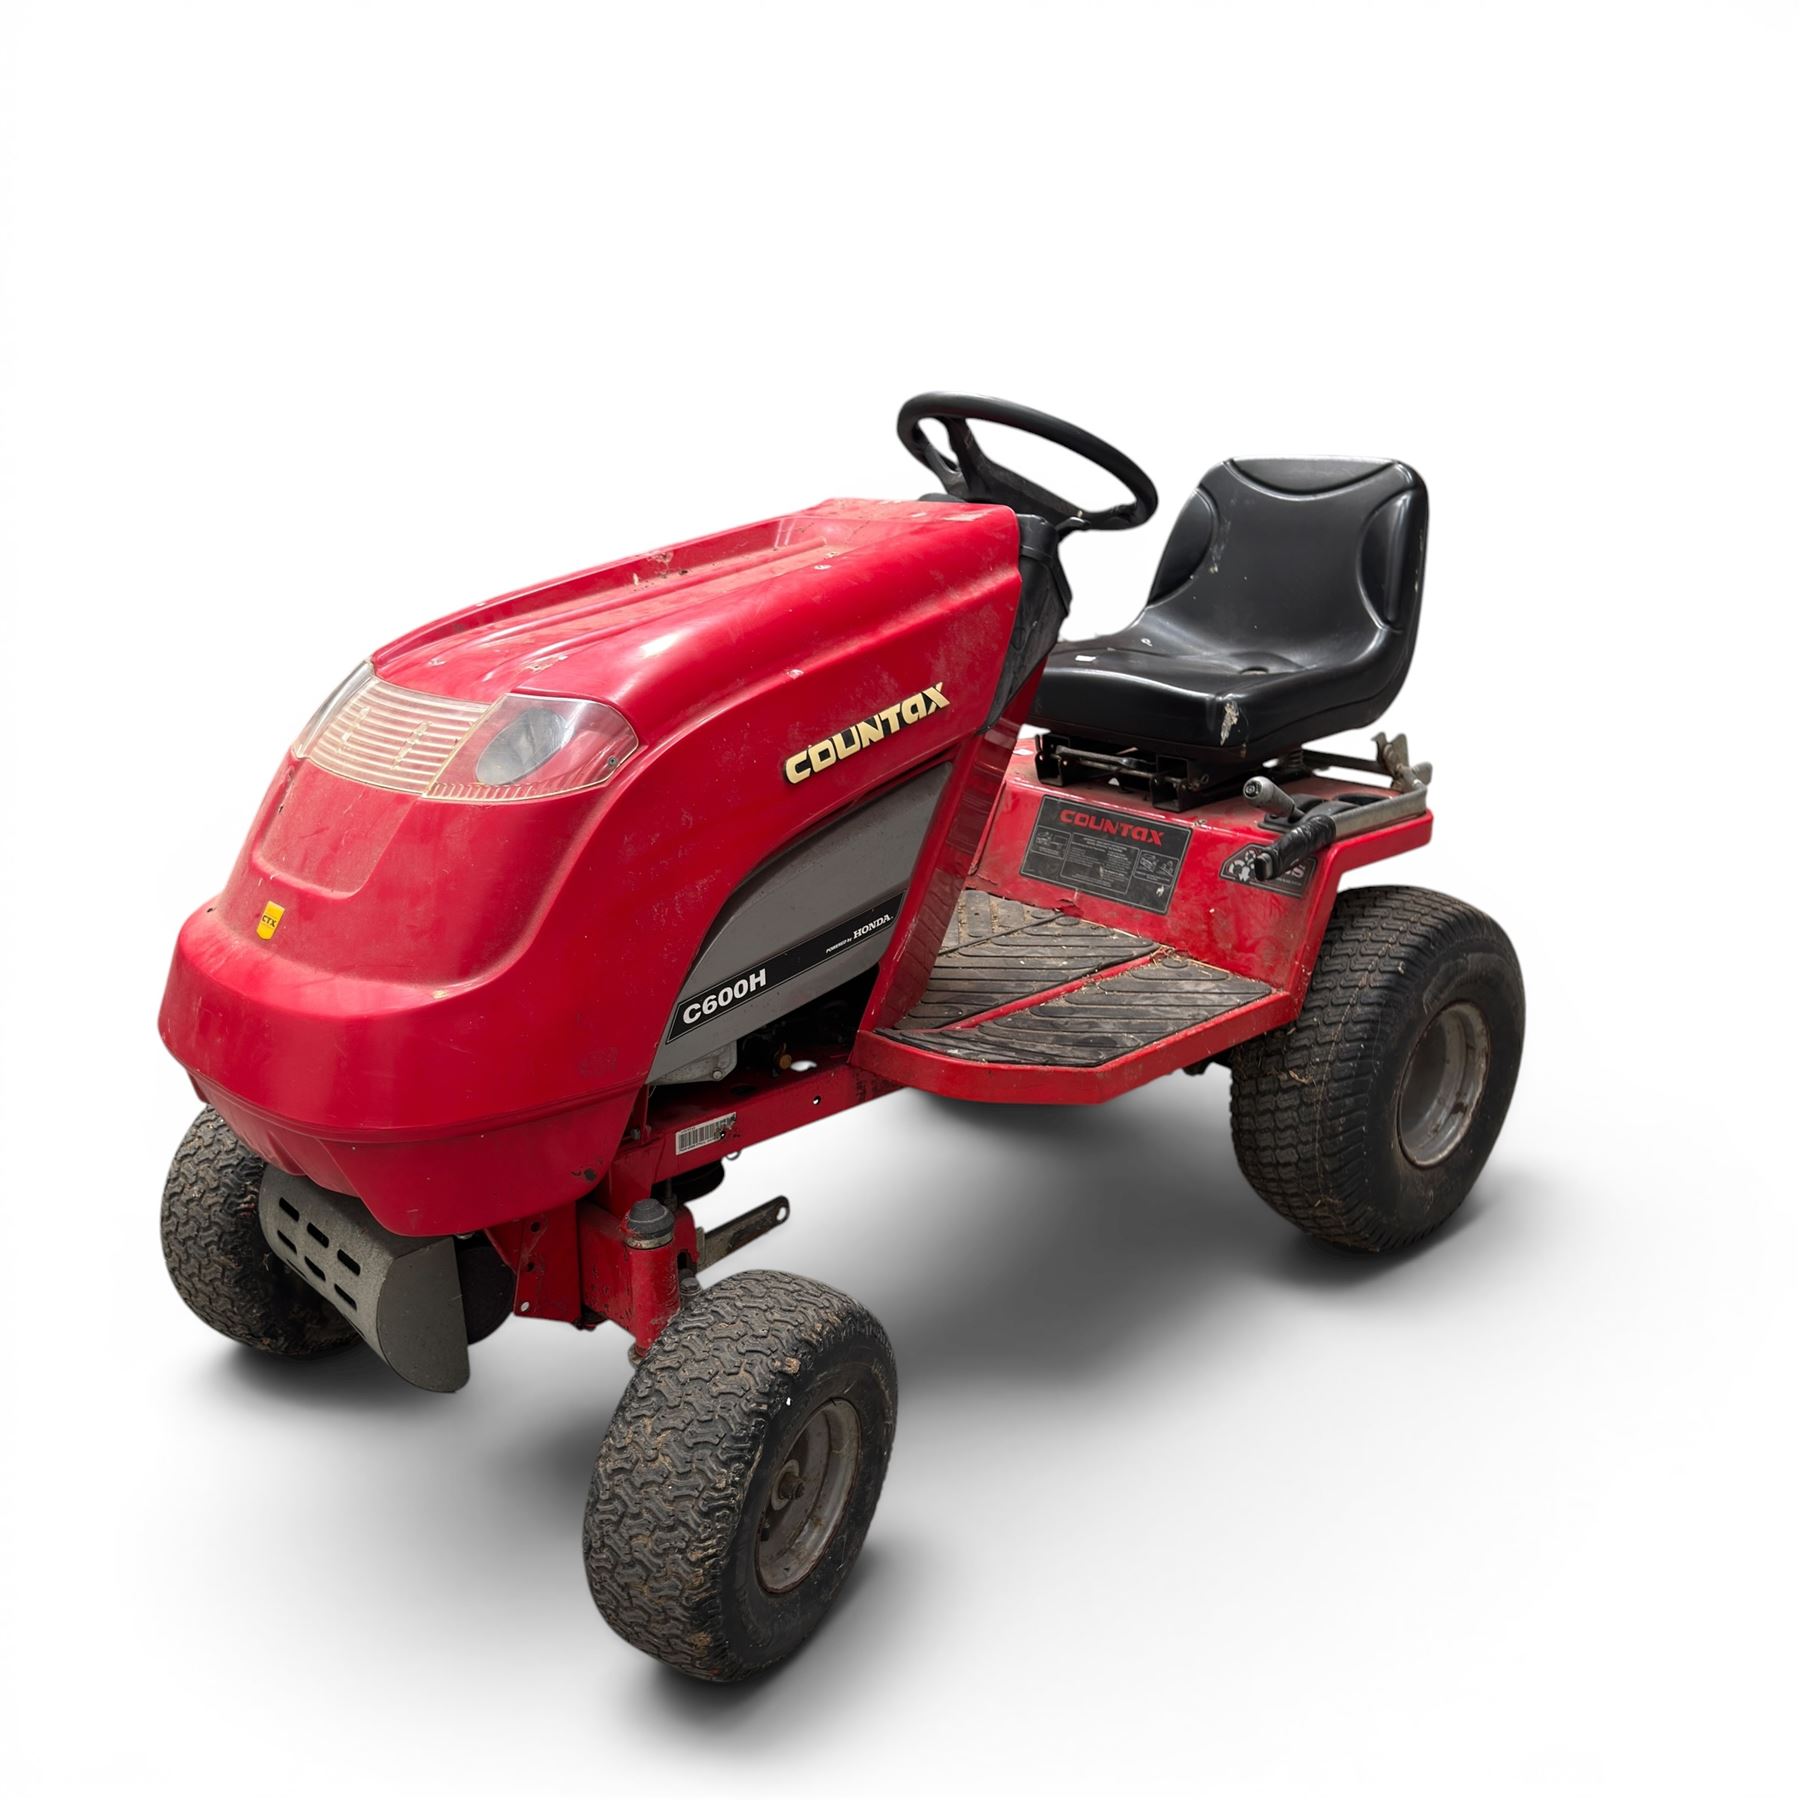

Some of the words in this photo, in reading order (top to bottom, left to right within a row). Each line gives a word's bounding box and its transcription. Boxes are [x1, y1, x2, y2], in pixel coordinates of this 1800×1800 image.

[785, 681, 951, 784] COUNTAX
[1058, 809, 1166, 848] COUNTAX
[262, 914, 277, 928] CTX
[853, 914, 891, 939] HONDA
[682, 968, 767, 1025] C600H
